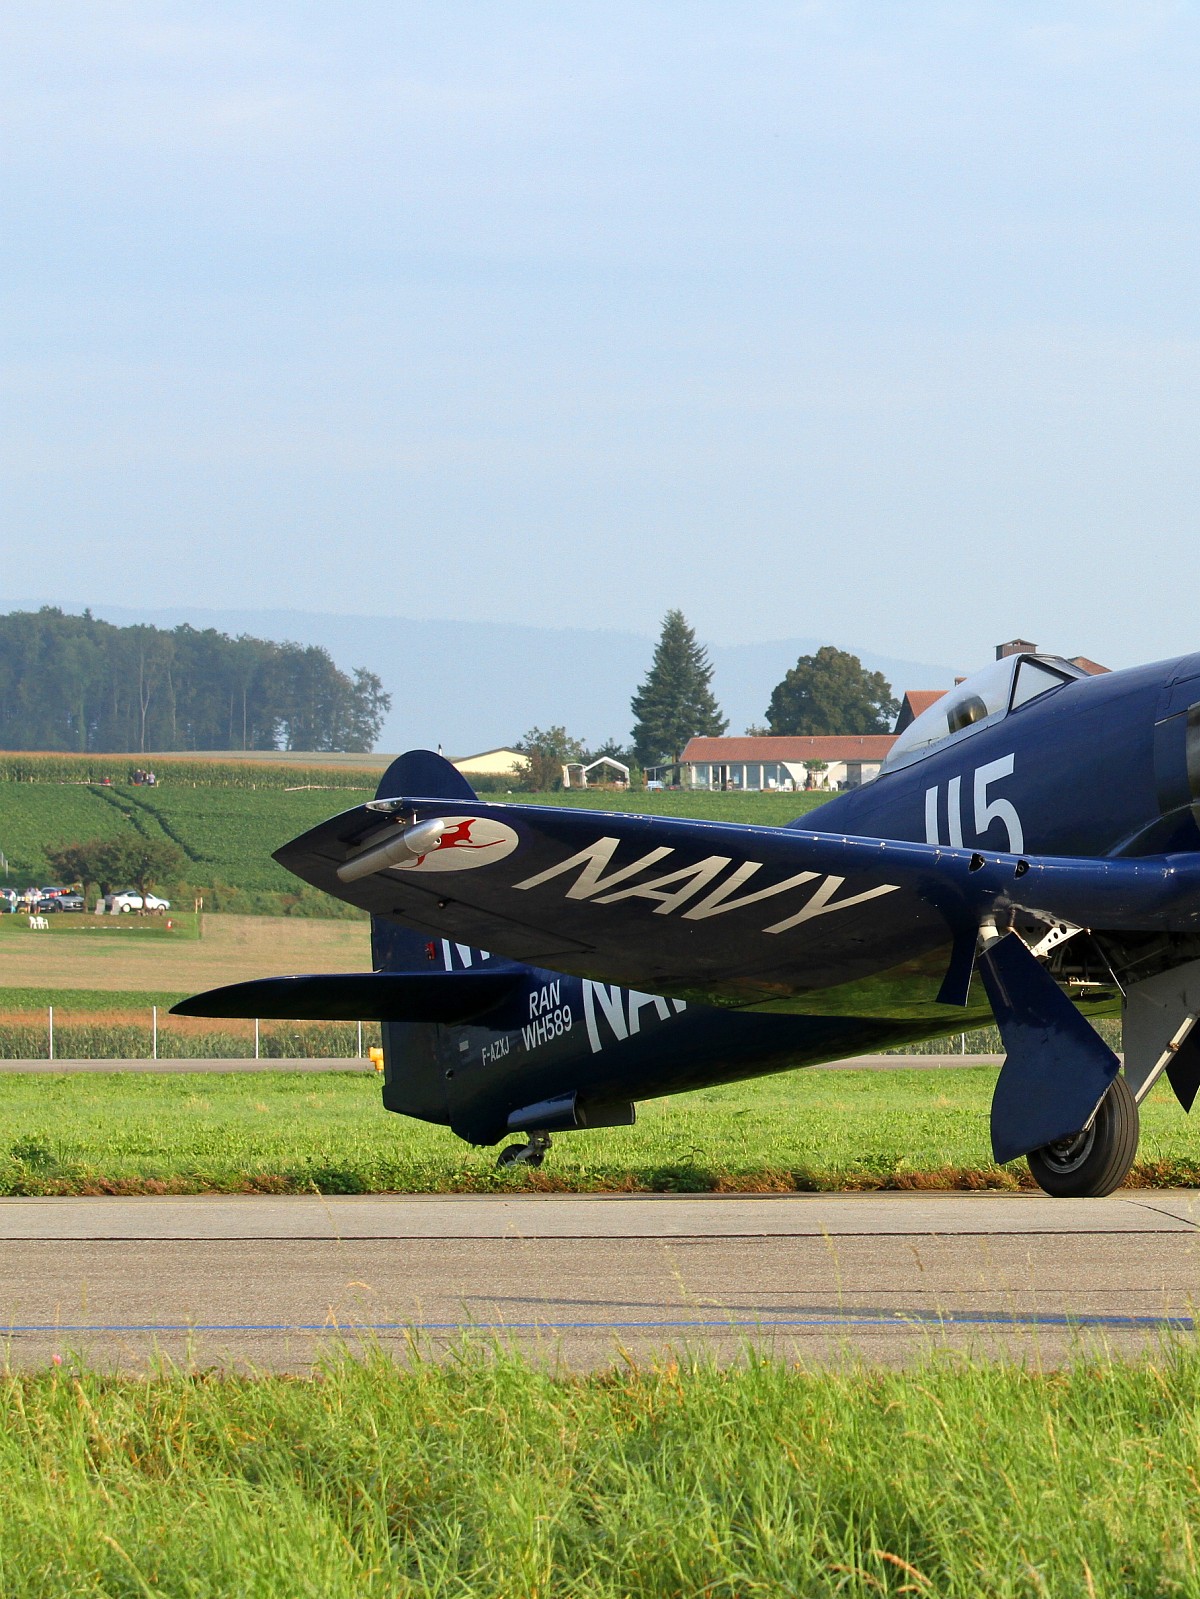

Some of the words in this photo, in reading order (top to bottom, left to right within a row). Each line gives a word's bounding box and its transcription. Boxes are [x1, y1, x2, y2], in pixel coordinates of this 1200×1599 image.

[925, 751, 1024, 855] 115
[511, 836, 901, 935] NAVY
[529, 979, 561, 1019] RAN
[481, 1035, 510, 1067] F-AZXJ
[521, 1005, 572, 1052] WH589
